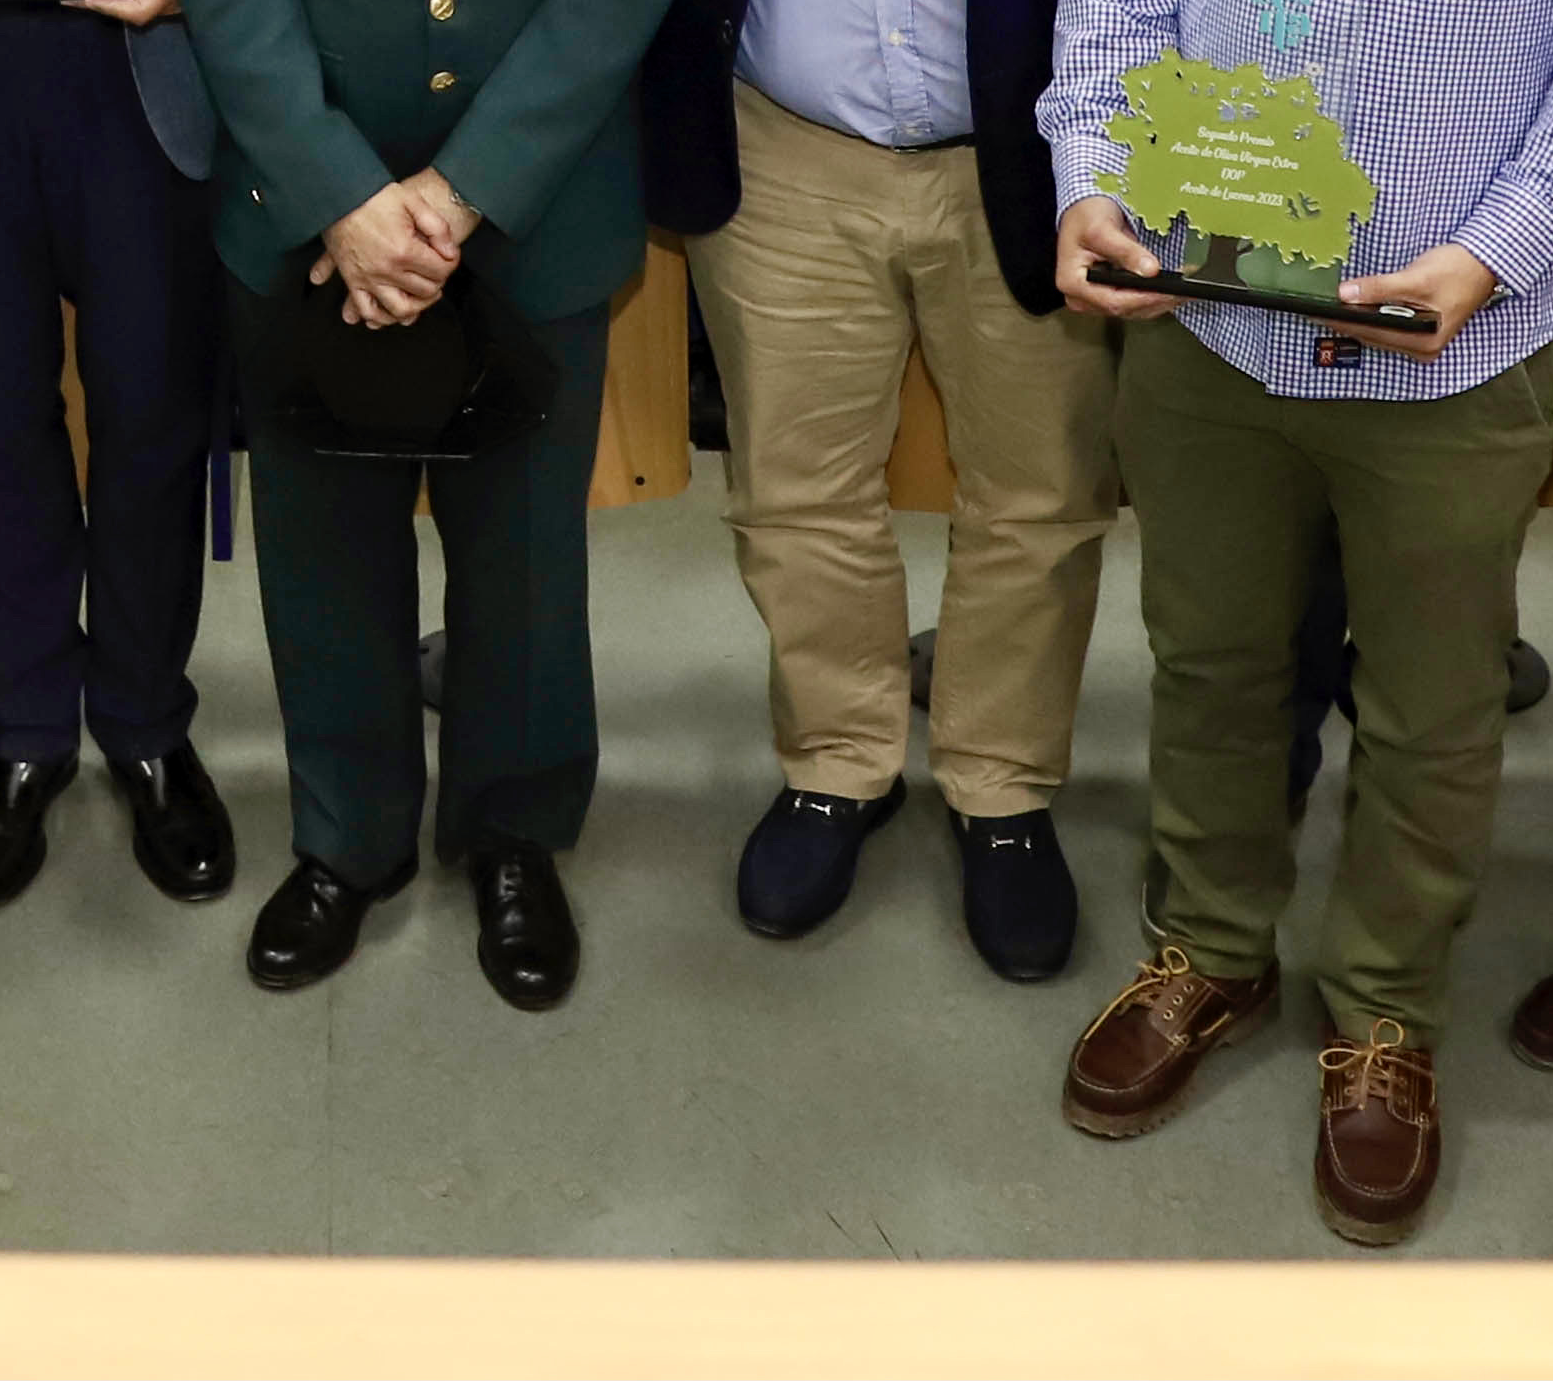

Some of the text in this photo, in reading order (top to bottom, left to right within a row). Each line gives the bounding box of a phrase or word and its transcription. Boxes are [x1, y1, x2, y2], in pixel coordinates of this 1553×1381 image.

[1197, 125, 1275, 147] Segundo Premio
[1170, 141, 1300, 170] Aceite de Oliva Virgen Extra
[1180, 181, 1284, 207] Aceite de Lucena 2023
